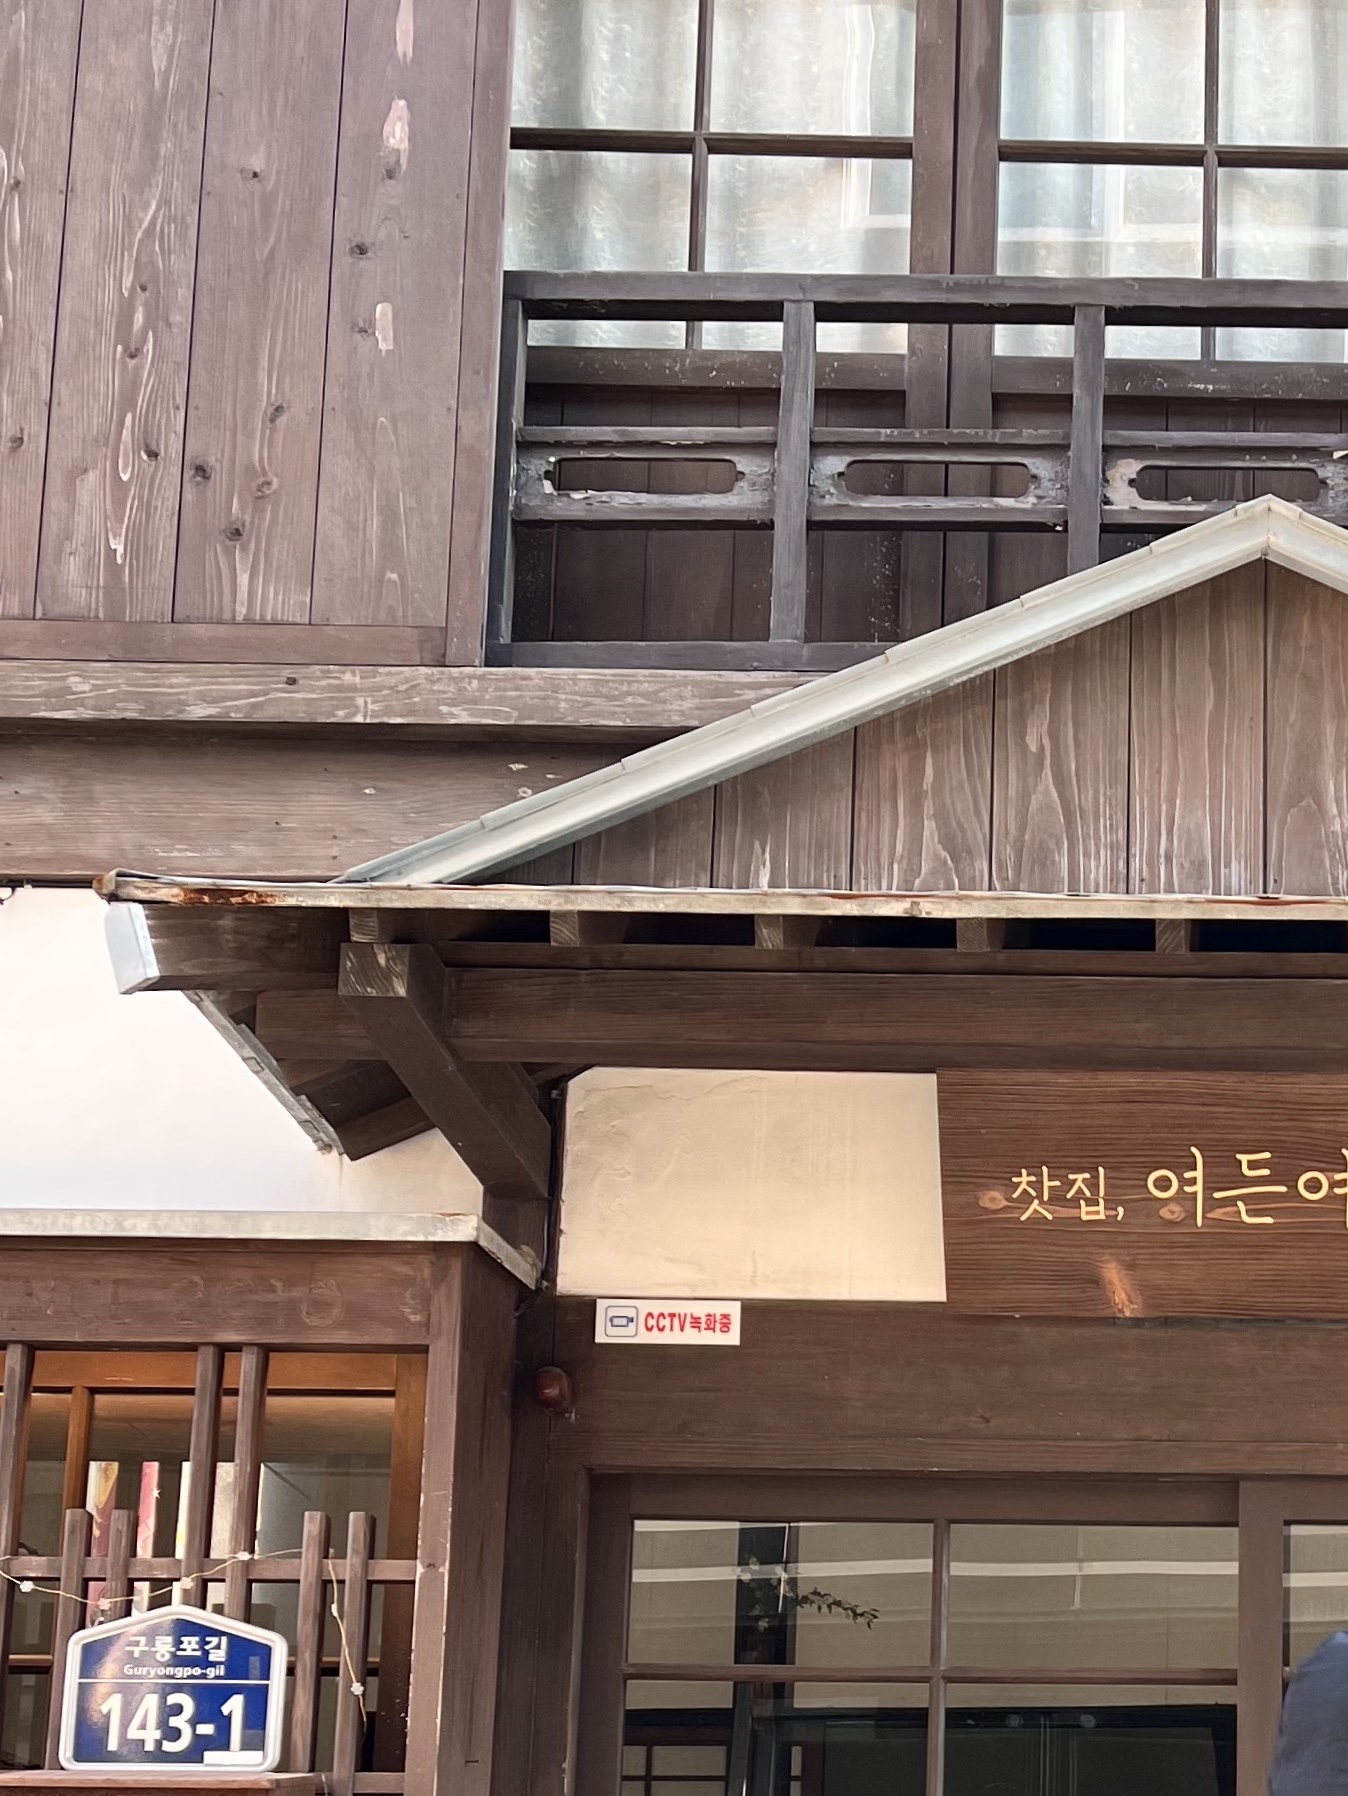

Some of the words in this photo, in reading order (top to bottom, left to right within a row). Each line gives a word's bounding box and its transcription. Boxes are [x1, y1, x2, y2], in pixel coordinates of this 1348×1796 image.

[1012, 1165, 1125, 1222] 찻집,
[124, 1636, 227, 1662] 구룡포길
[123, 1664, 225, 1679] Guryongpo-gil
[99, 1692, 246, 1752] 143-1
